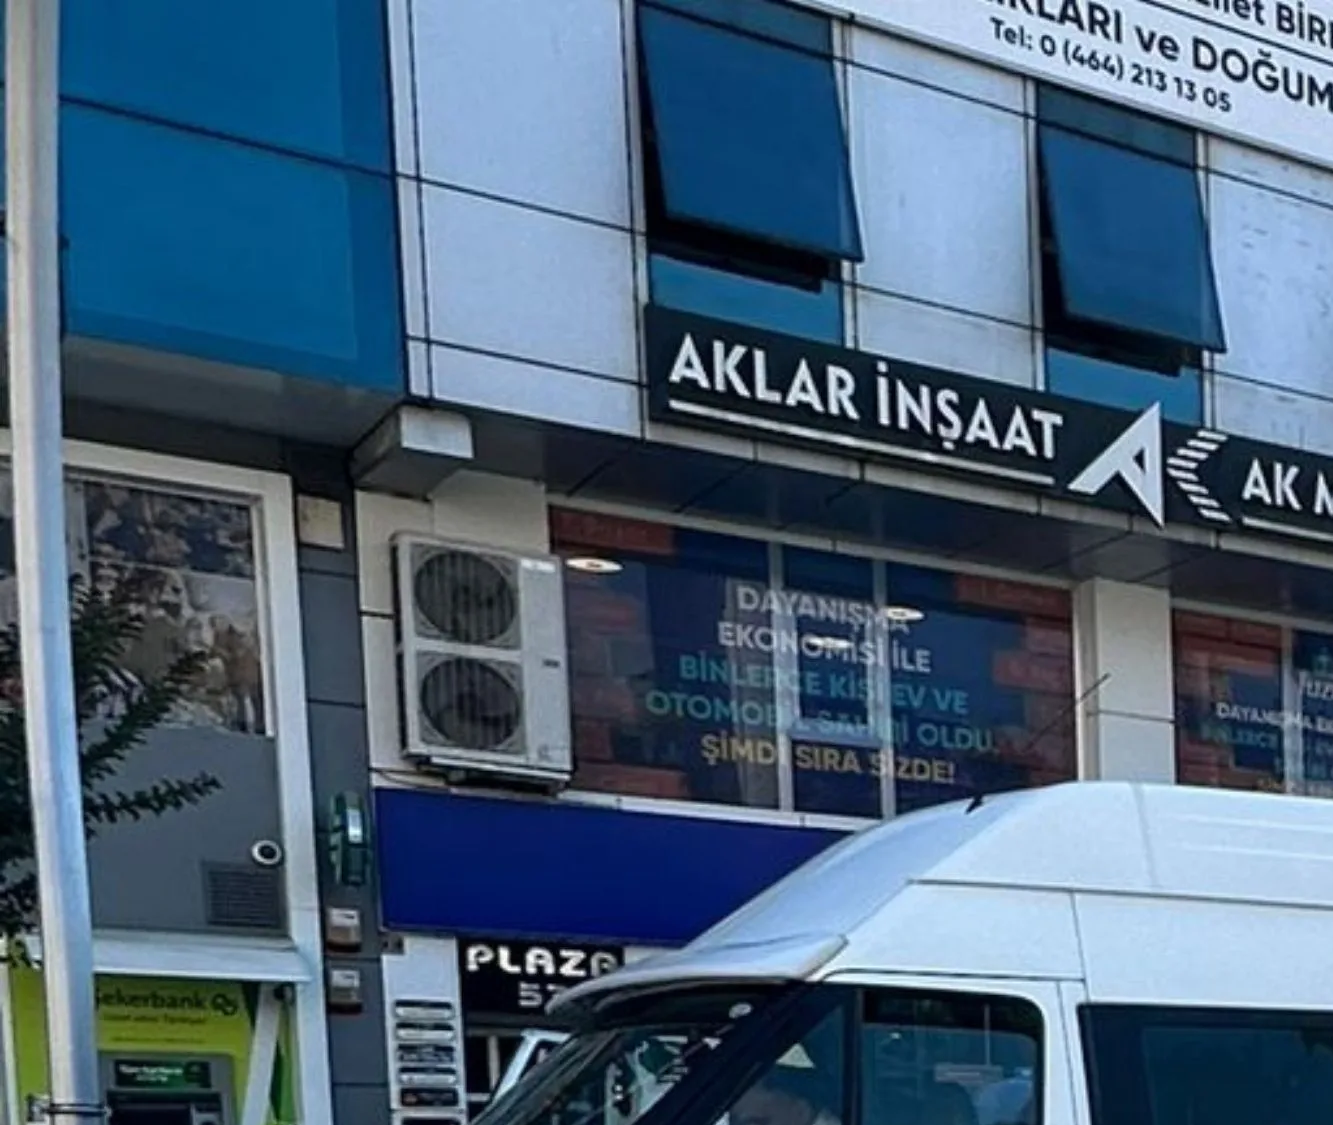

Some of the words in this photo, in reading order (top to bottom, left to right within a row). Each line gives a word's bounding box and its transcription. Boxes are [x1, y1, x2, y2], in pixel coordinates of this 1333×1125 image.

[989, 16, 1033, 50] Tel:
[1039, 34, 1057, 57] 0
[1063, 39, 1124, 82] (464)
[1131, 63, 1168, 92] 213
[1175, 75, 1197, 101] 13
[1203, 86, 1232, 113] 05
[1135, 25, 1179, 60] ve
[669, 332, 860, 421] AKLAR
[876, 360, 1063, 460] İNŞAAT
[1241, 458, 1302, 512] AK
[645, 688, 811, 733] OTOMOBL
[933, 687, 969, 716] VE
[701, 731, 787, 766] ŞİMD
[796, 744, 864, 776] SIRA
[466, 943, 619, 979] PLAZA
[97, 987, 207, 1012] ekerbank
